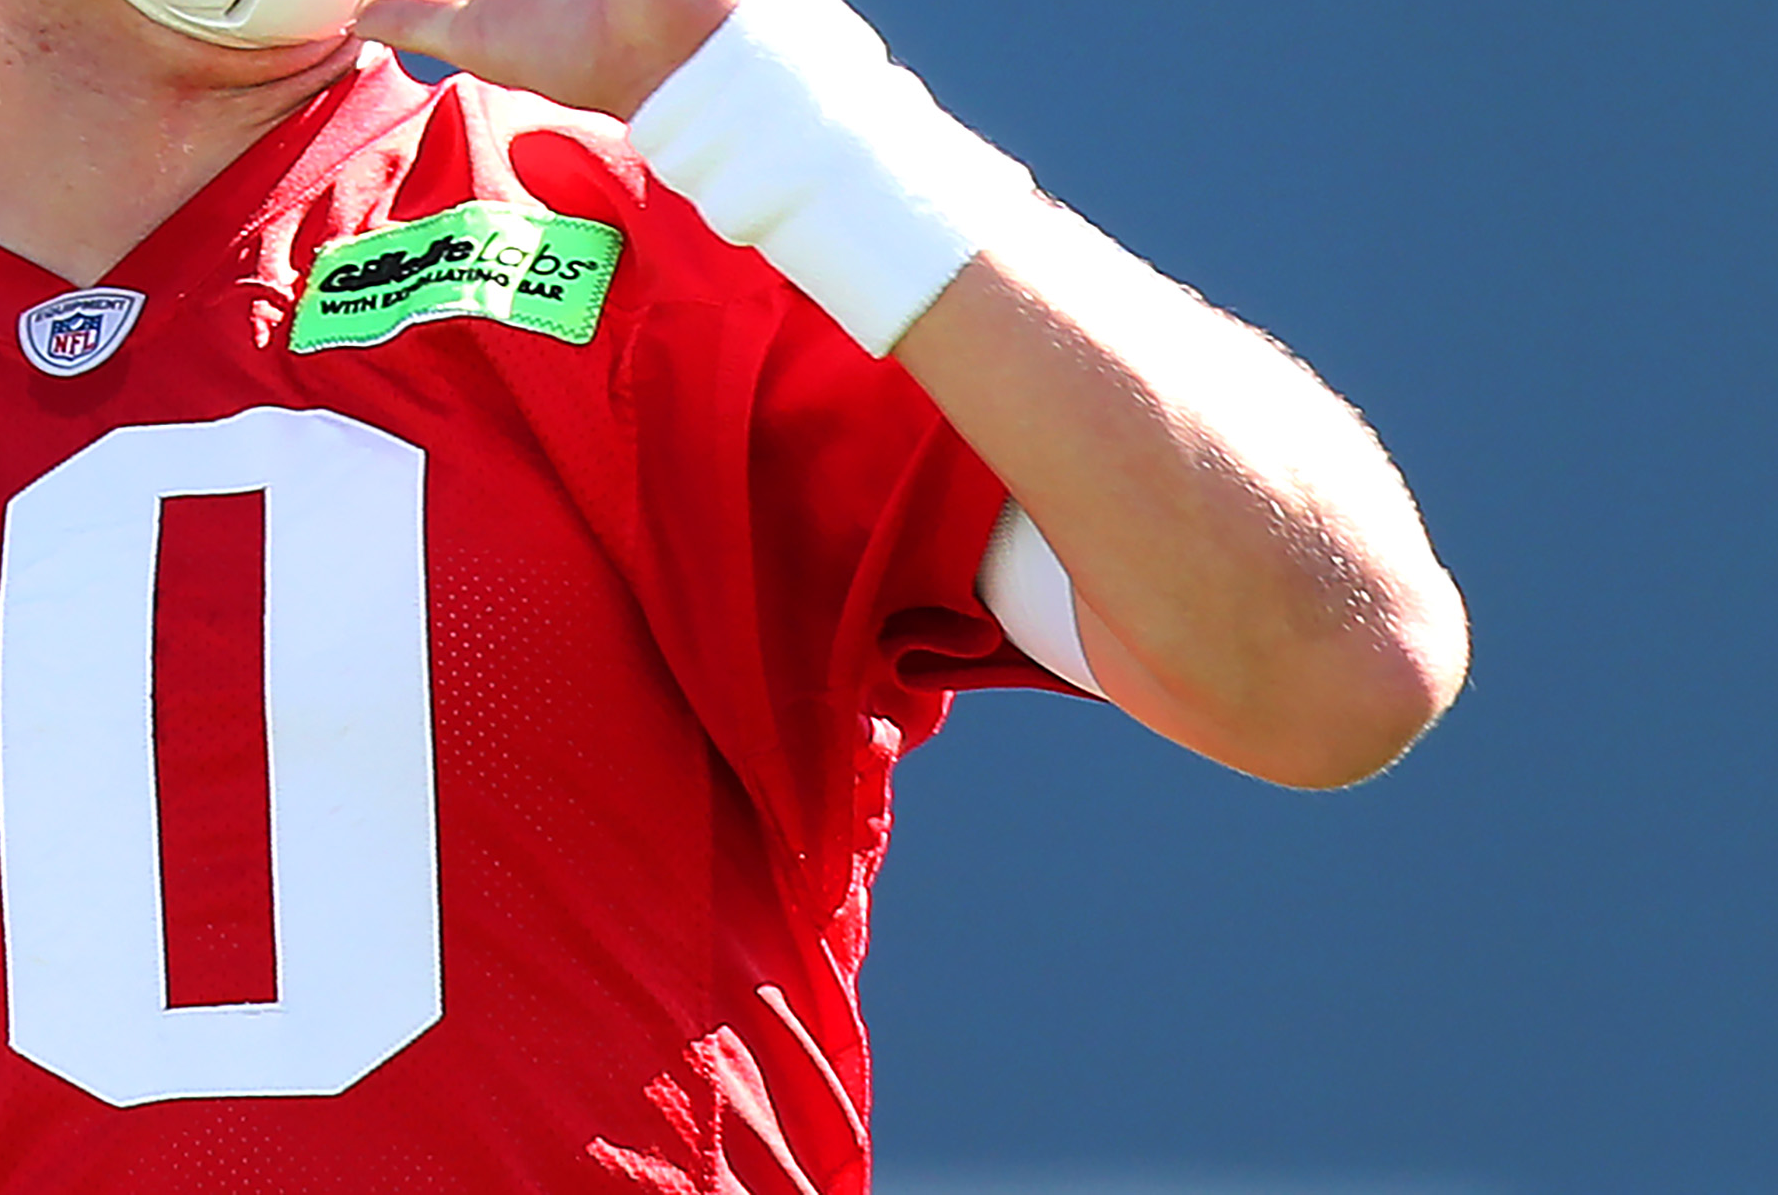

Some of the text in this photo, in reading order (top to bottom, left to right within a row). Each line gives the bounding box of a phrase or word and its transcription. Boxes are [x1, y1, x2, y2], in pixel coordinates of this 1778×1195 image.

[320, 295, 378, 314] WITH
[517, 279, 564, 302] BAR
[53, 330, 96, 355] NFL
